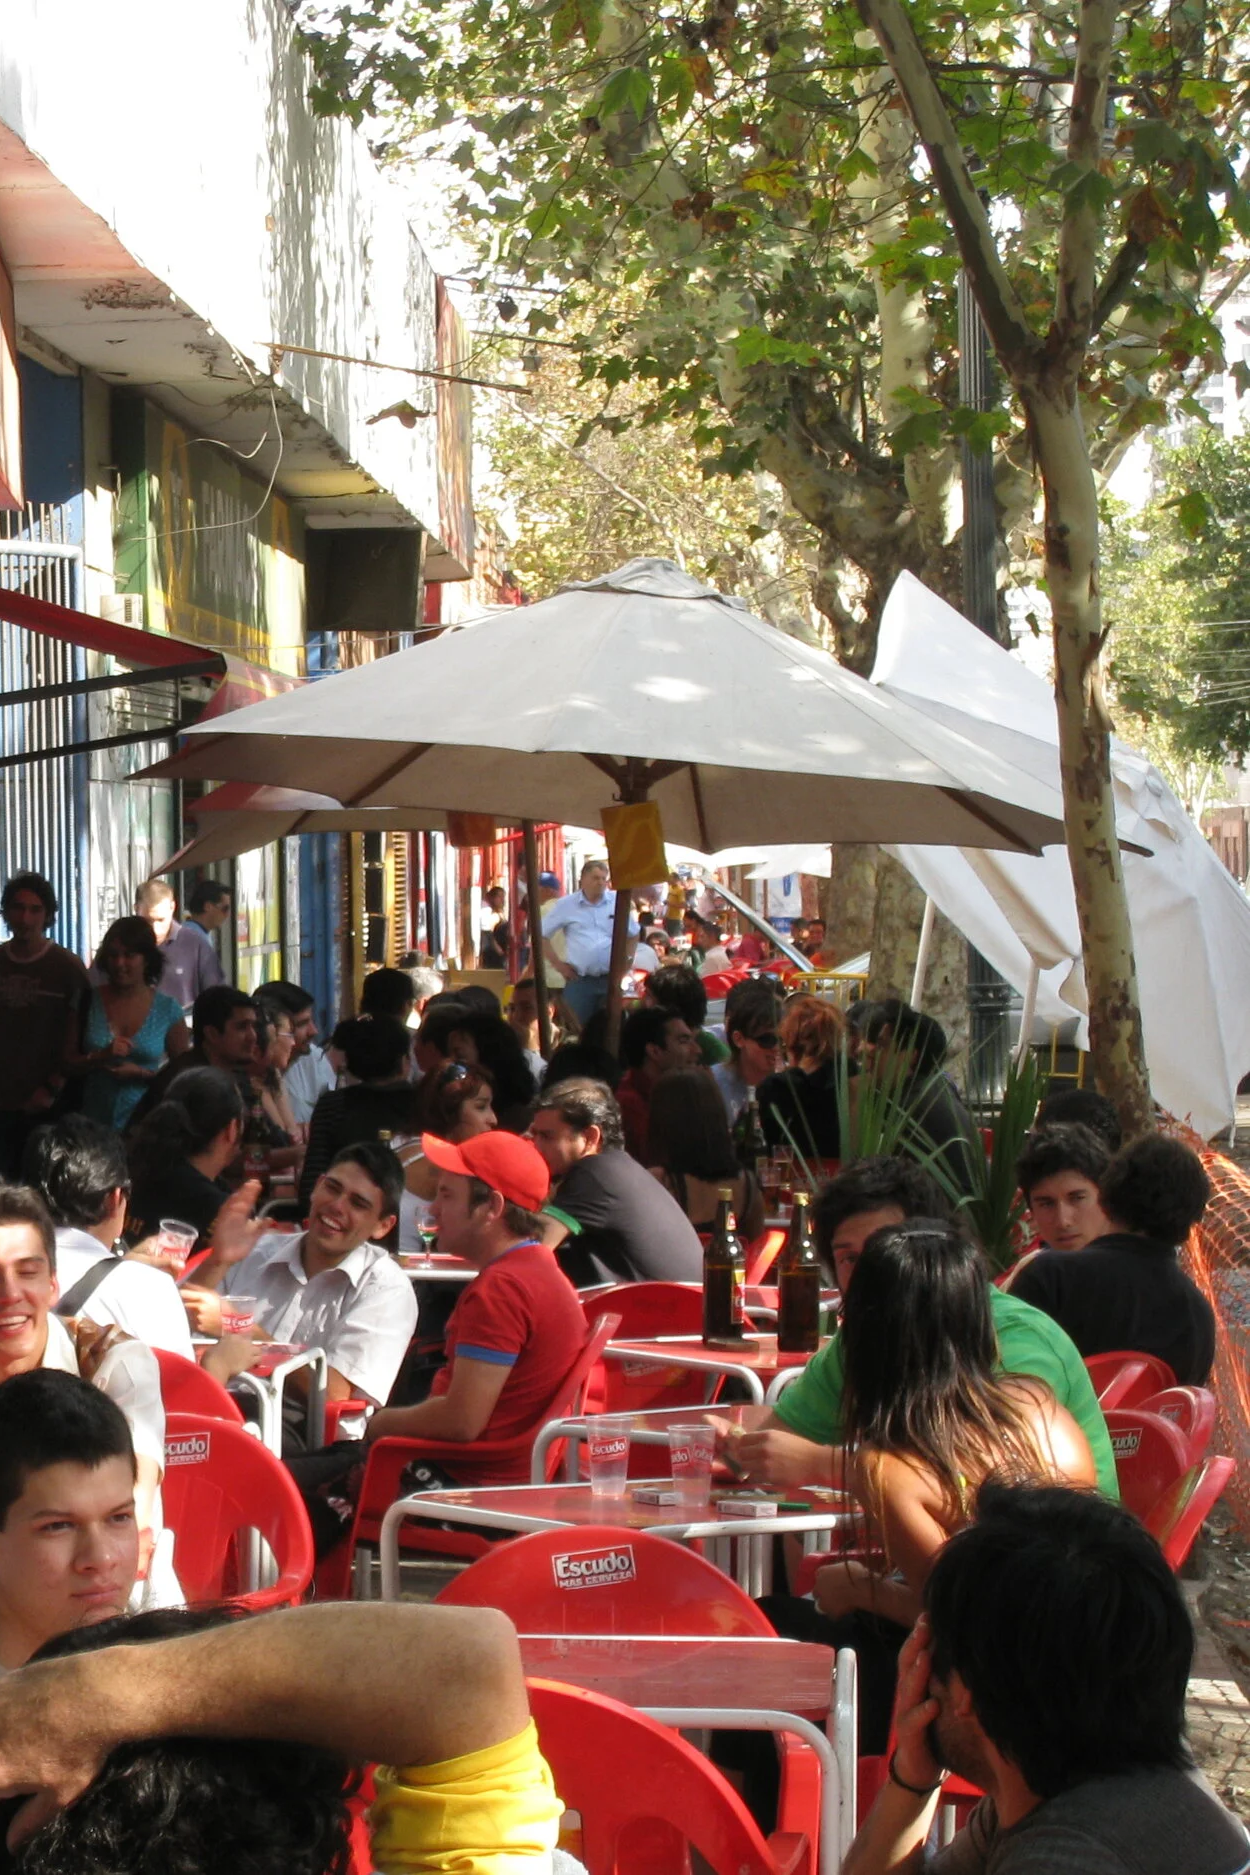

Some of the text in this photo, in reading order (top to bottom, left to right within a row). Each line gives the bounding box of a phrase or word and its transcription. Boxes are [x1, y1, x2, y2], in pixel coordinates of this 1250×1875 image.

[556, 1552, 630, 1578] Escudo
[559, 1570, 633, 1589] MAS CERVEZA
